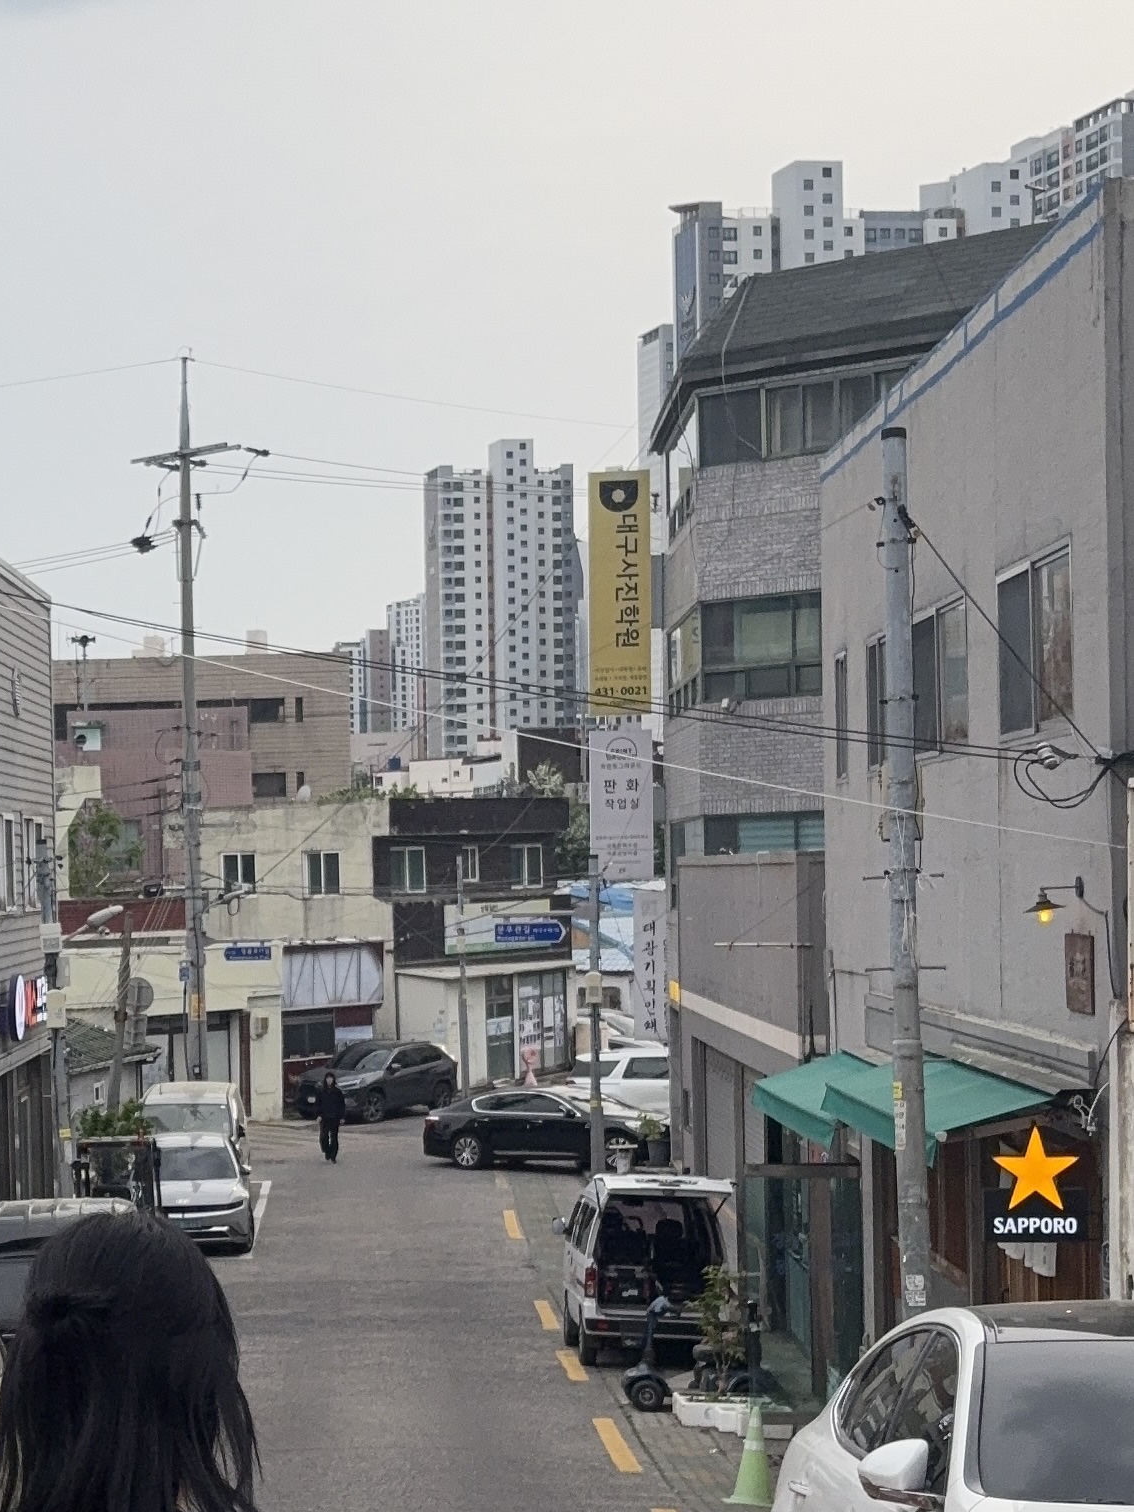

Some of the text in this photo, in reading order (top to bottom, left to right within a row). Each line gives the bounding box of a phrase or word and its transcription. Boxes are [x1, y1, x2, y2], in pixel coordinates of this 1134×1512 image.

[615, 513, 640, 648] 대구사진학원
[605, 798, 639, 810] 작업실
[993, 1216, 1078, 1235] SAPPORO
